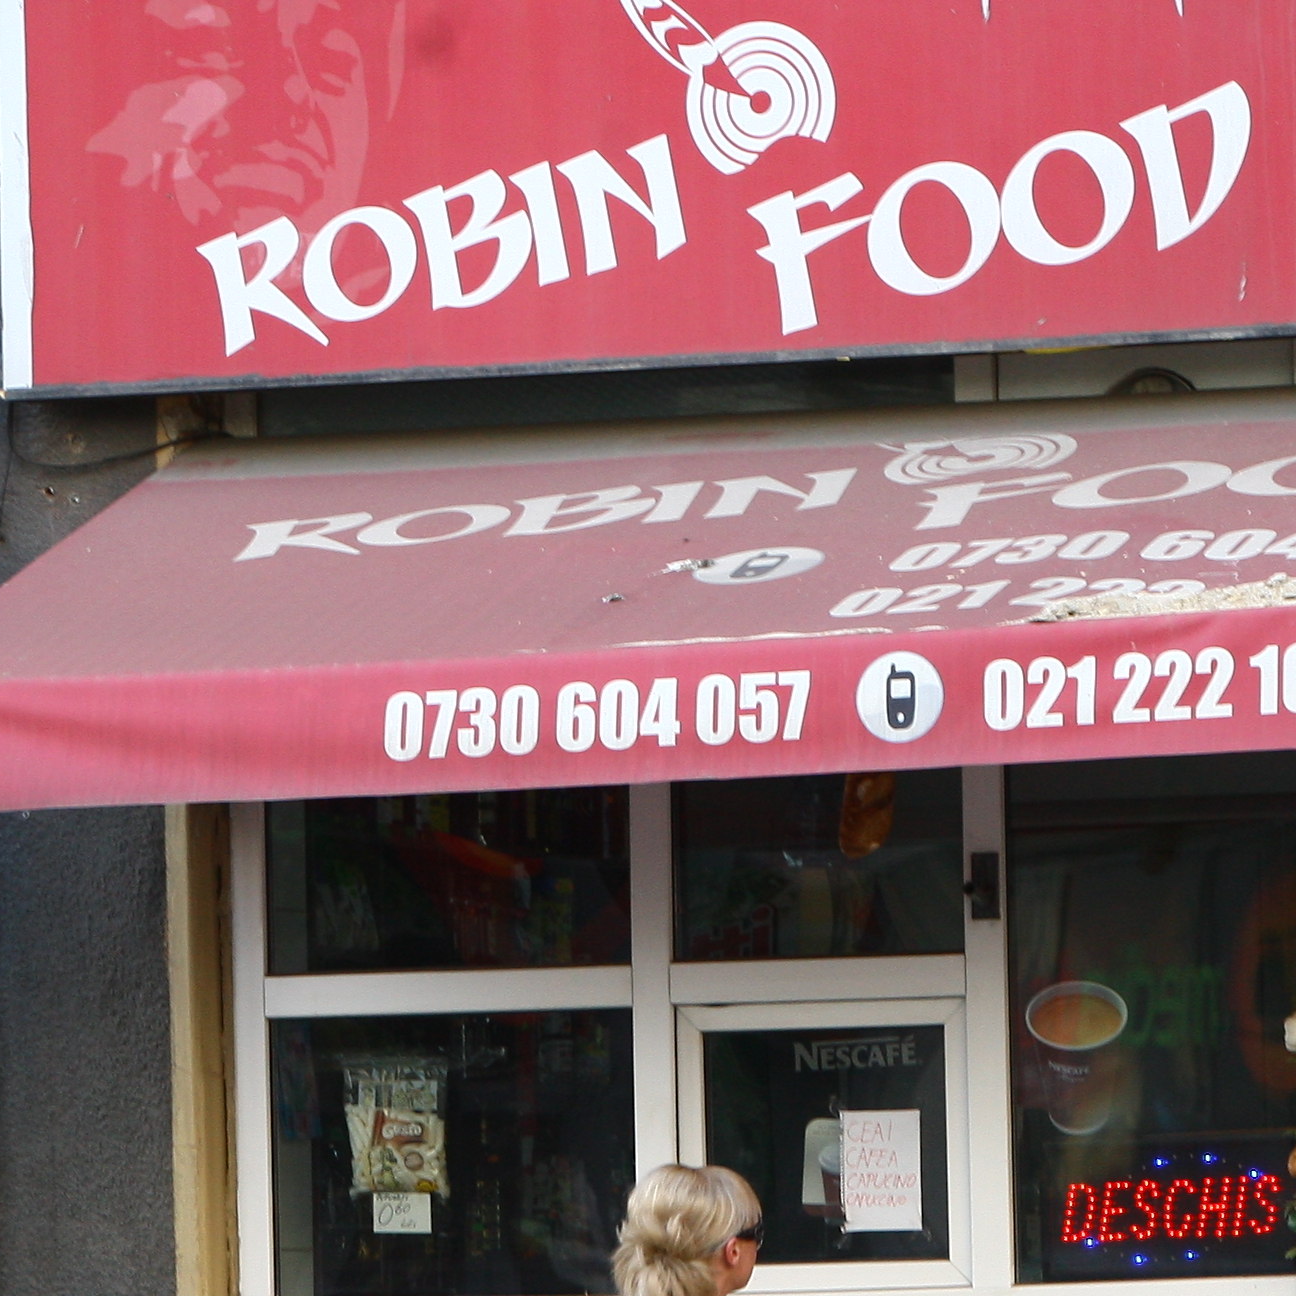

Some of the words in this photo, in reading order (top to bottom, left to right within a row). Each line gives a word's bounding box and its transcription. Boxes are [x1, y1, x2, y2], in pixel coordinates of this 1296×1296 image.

[196, 133, 687, 357] ROBIN
[747, 80, 1251, 336] FOOD
[236, 467, 857, 561] ROBIN
[889, 530, 1131, 571] 0730
[829, 580, 1010, 618] 021
[384, 684, 538, 761] 0730
[555, 678, 680, 753] 604
[702, 670, 810, 745] 057
[984, 658, 1095, 730] 021
[1113, 650, 1233, 722] 222
[794, 1034, 917, 1072] NESCAFÉ
[847, 1119, 892, 1144] CEAI
[846, 1147, 899, 1169] CAFEA
[1061, 1173, 1281, 1242] DESCHIS
